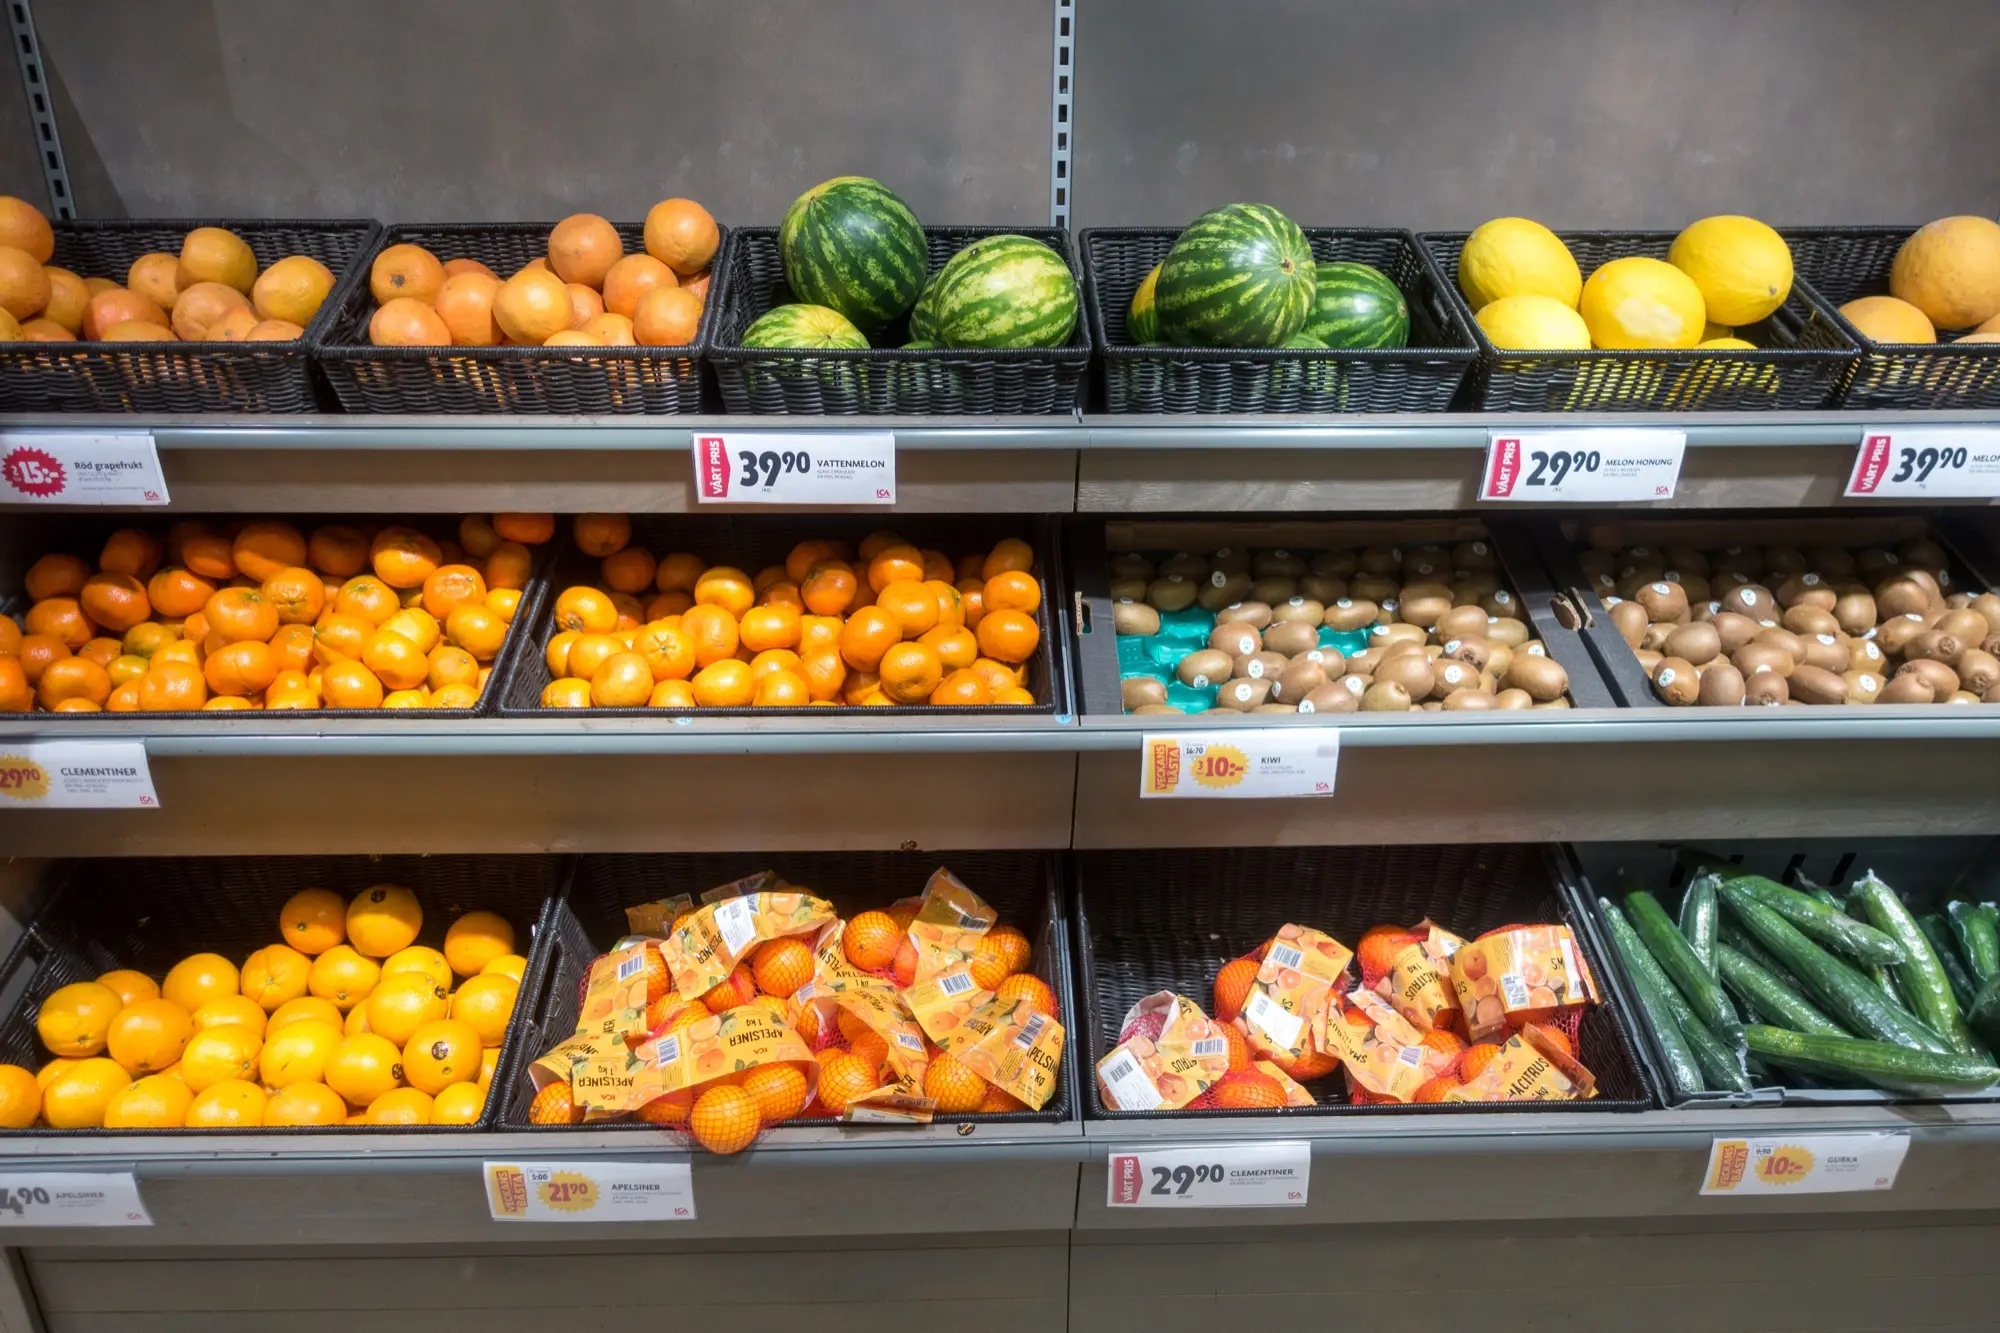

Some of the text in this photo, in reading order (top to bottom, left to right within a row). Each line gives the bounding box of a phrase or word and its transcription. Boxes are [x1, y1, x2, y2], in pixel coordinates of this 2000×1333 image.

[1871, 438, 1887, 461] PRIS
[73, 461, 144, 472] Röd grapefrukt
[816, 459, 885, 468] VATTENMELON
[1605, 458, 1673, 466] MELON HONUNG
[709, 440, 723, 494] VÅRT PRIS
[1496, 441, 1516, 494] VÅRT PRIS
[876, 488, 891, 497] ICA
[1655, 485, 1669, 493] ICA
[143, 490, 159, 499] ICA
[1167, 748, 1180, 784] BÄSTA
[60, 767, 137, 777] CLEMENTINER
[1315, 782, 1330, 790] ICA
[728, 1028, 783, 1047] APELSINER
[753, 1047, 768, 1055] ICA
[578, 1076, 634, 1088] APELSINER
[1230, 1168, 1294, 1177] CLEMENTINER
[1121, 1159, 1134, 1202] VÅRT PRIS
[611, 1183, 661, 1191] APELSINER
[56, 1191, 105, 1199] APELSINER
